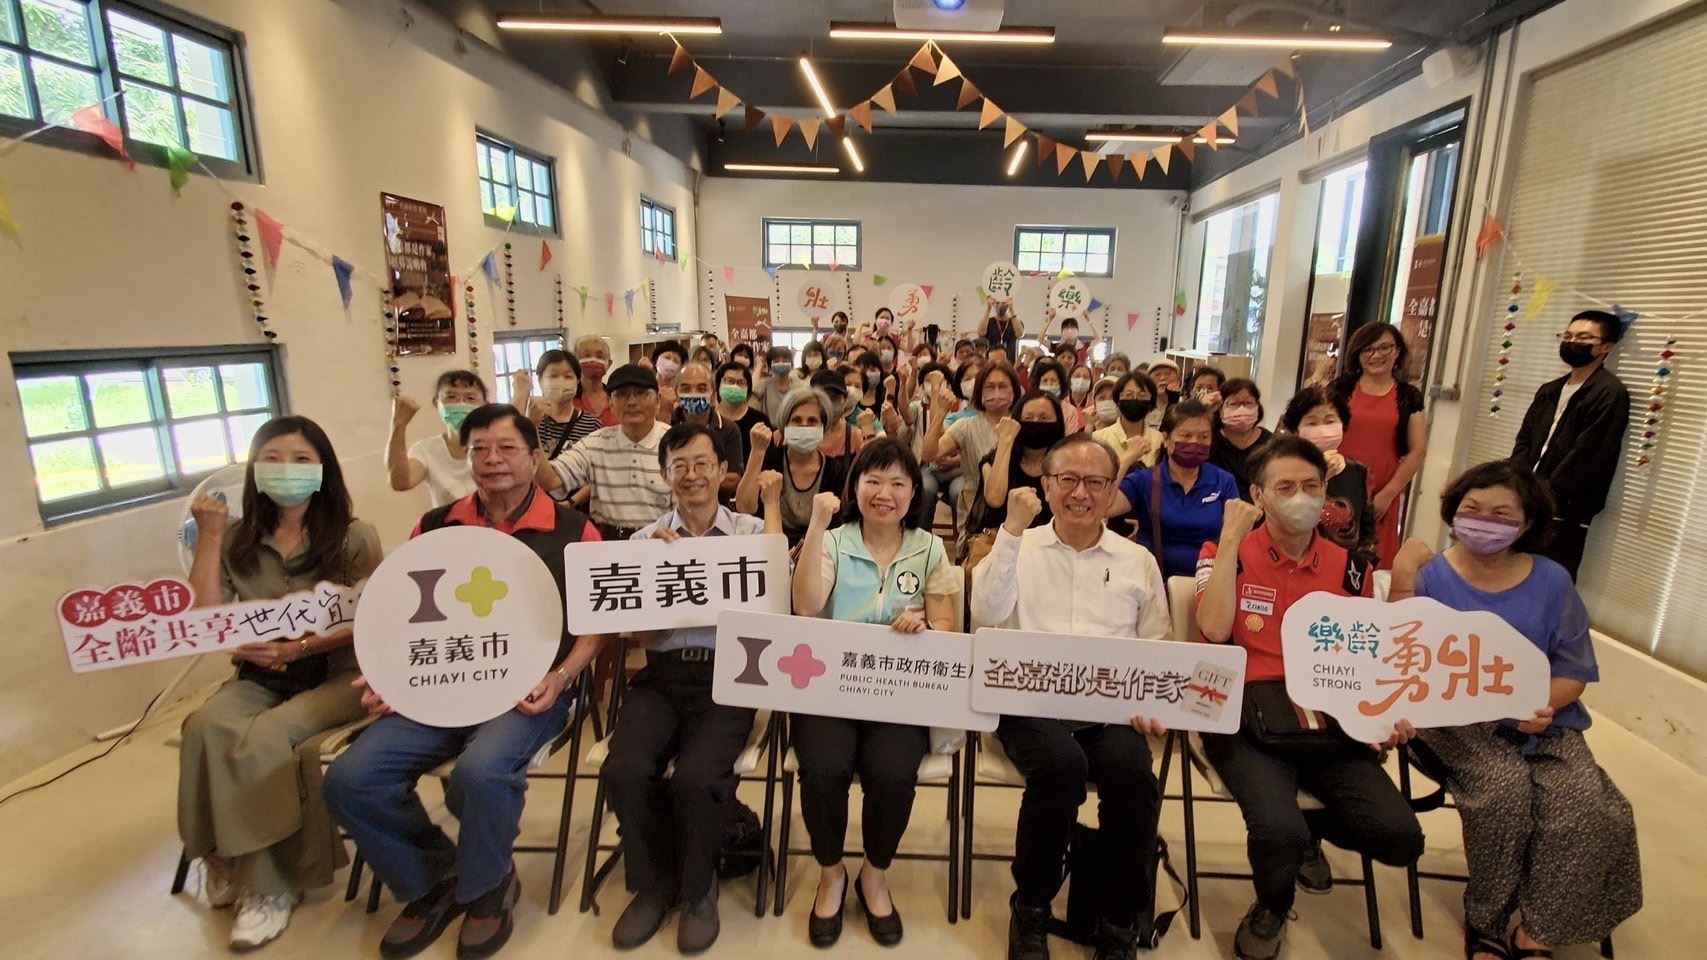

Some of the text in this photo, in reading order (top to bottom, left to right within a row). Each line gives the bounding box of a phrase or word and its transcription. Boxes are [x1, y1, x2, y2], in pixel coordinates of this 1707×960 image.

[897, 289, 920, 317] 勇
[588, 555, 768, 612] 嘉義市
[75, 585, 180, 624] 嘉義市
[408, 632, 510, 666] 嘉義市
[1308, 616, 1381, 658] 樂齡
[409, 668, 509, 687] CHIAYI CITY
[841, 651, 974, 679] 嘉義市政府衛生
[1198, 670, 1232, 688] GIFT
[1313, 664, 1355, 677] CHIAYI
[1358, 620, 1515, 717] 勇壯
[839, 684, 895, 697] CHIAYI CITY
[840, 673, 949, 691] PUBLIC HEALTH BUREAU
[984, 656, 1191, 703] 全嘉都是作家
[1312, 677, 1362, 691] STRONG
